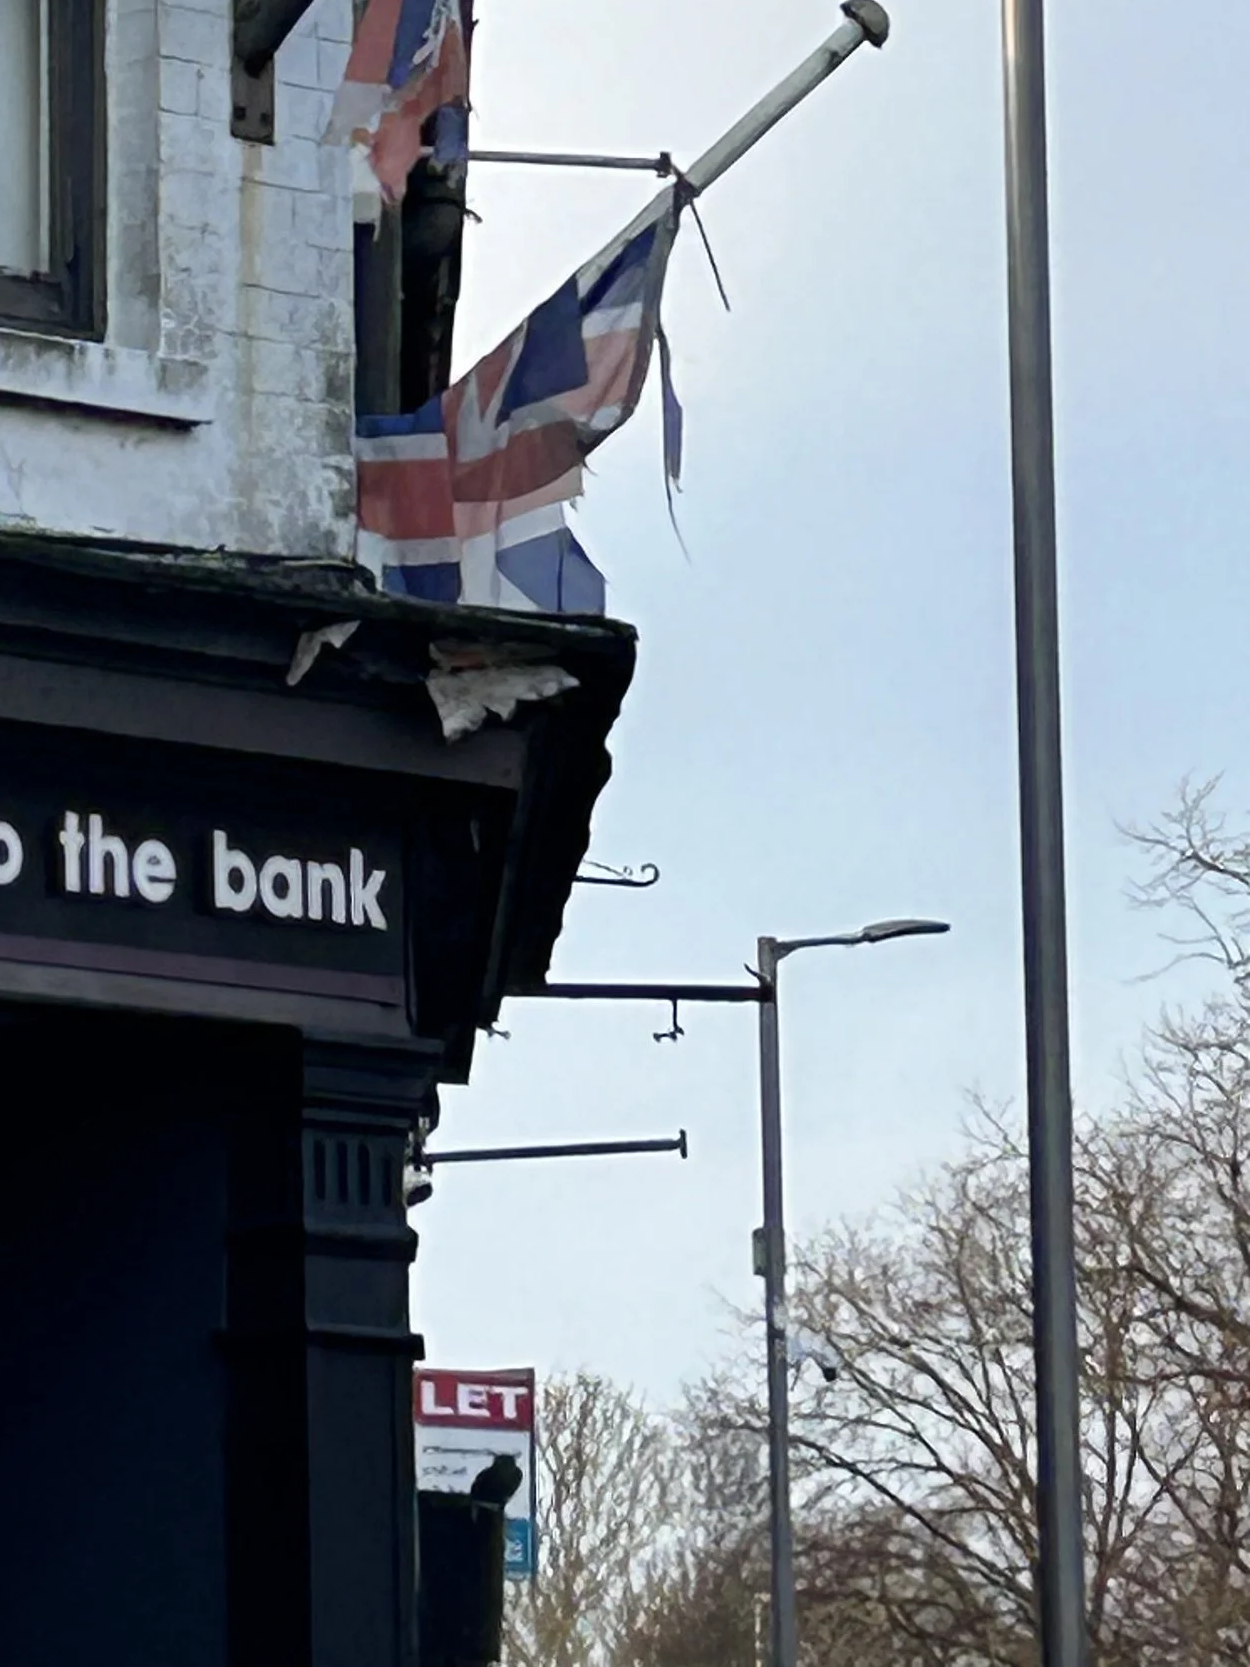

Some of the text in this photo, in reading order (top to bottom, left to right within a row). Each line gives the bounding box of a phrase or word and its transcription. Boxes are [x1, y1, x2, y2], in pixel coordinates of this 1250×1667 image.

[59, 810, 178, 903] the
[212, 829, 388, 930] bank
[421, 1381, 528, 1419] LET
